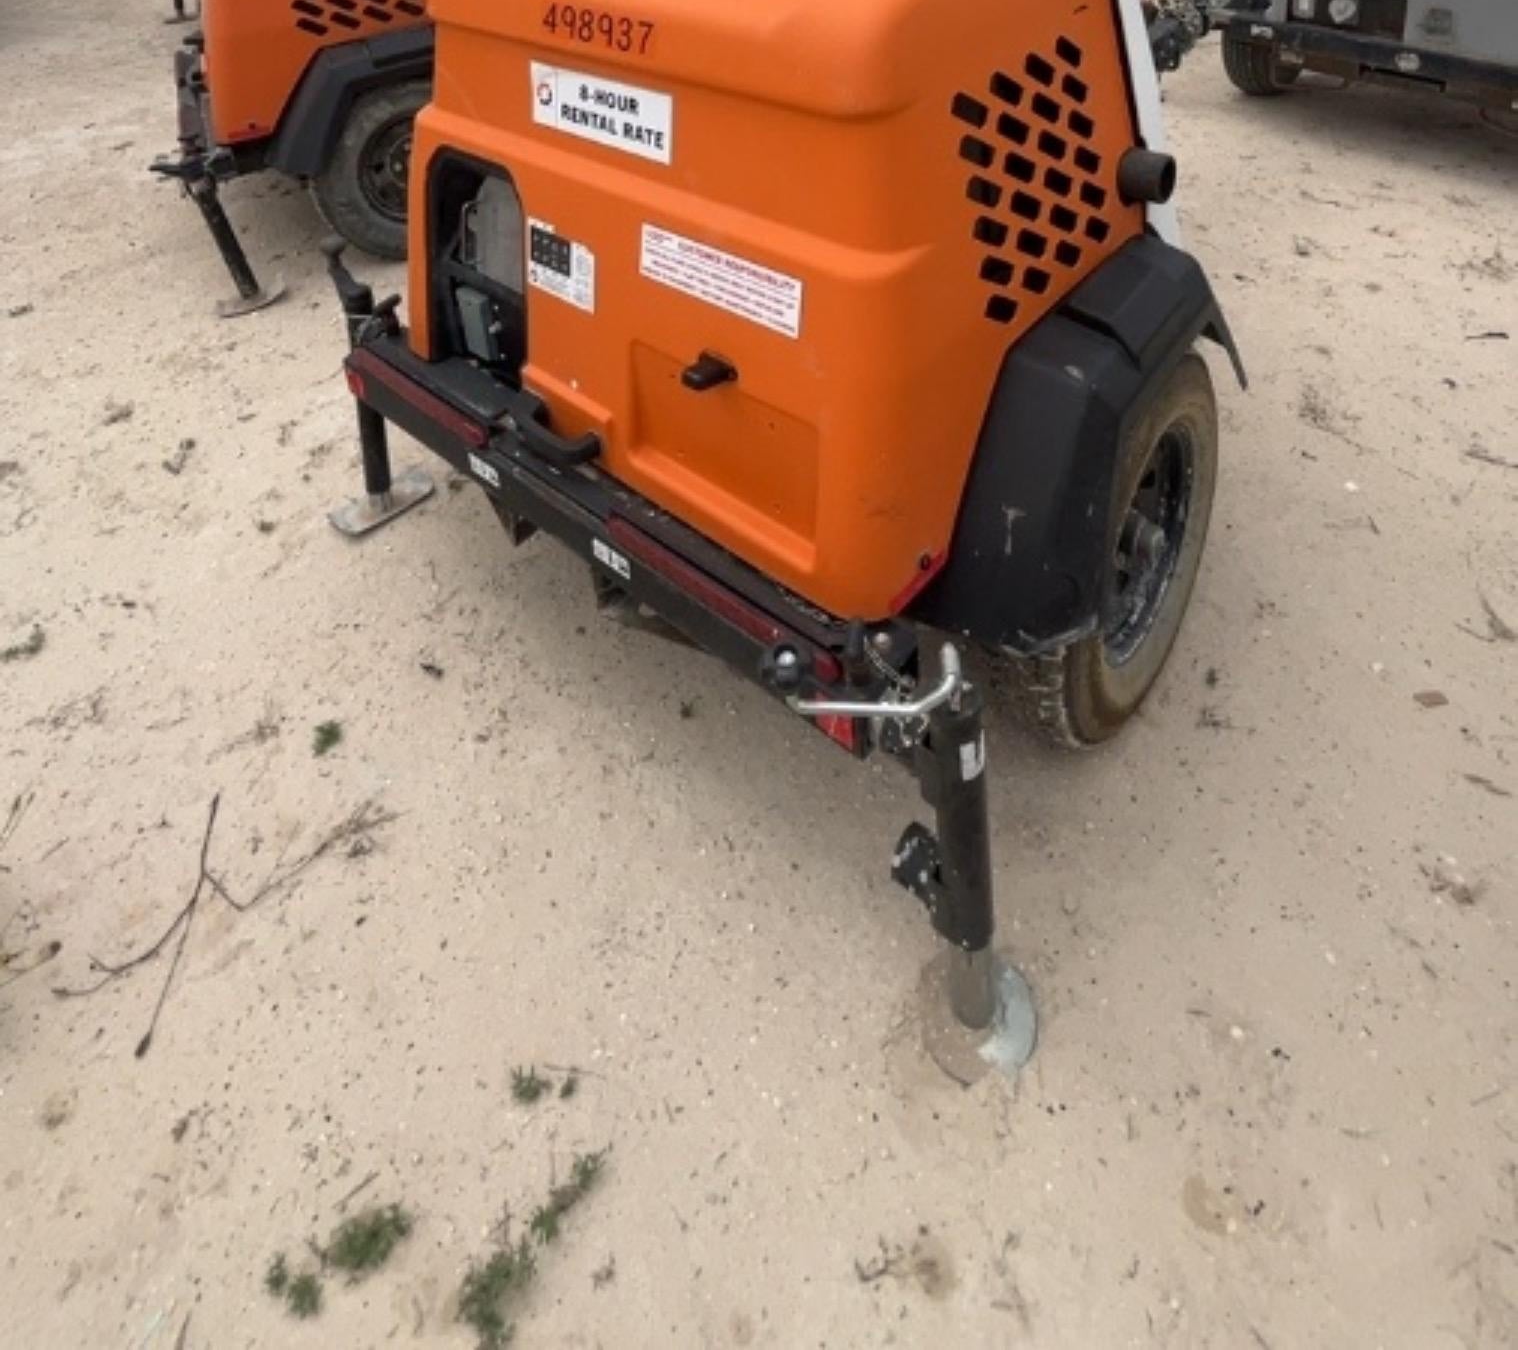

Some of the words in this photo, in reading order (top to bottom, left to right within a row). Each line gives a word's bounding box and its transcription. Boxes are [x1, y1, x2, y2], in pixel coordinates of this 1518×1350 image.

[542, 3, 655, 54] 498937
[578, 84, 639, 115] 8-HOUR
[560, 104, 618, 136] RENTAL
[622, 122, 664, 151] RATE
